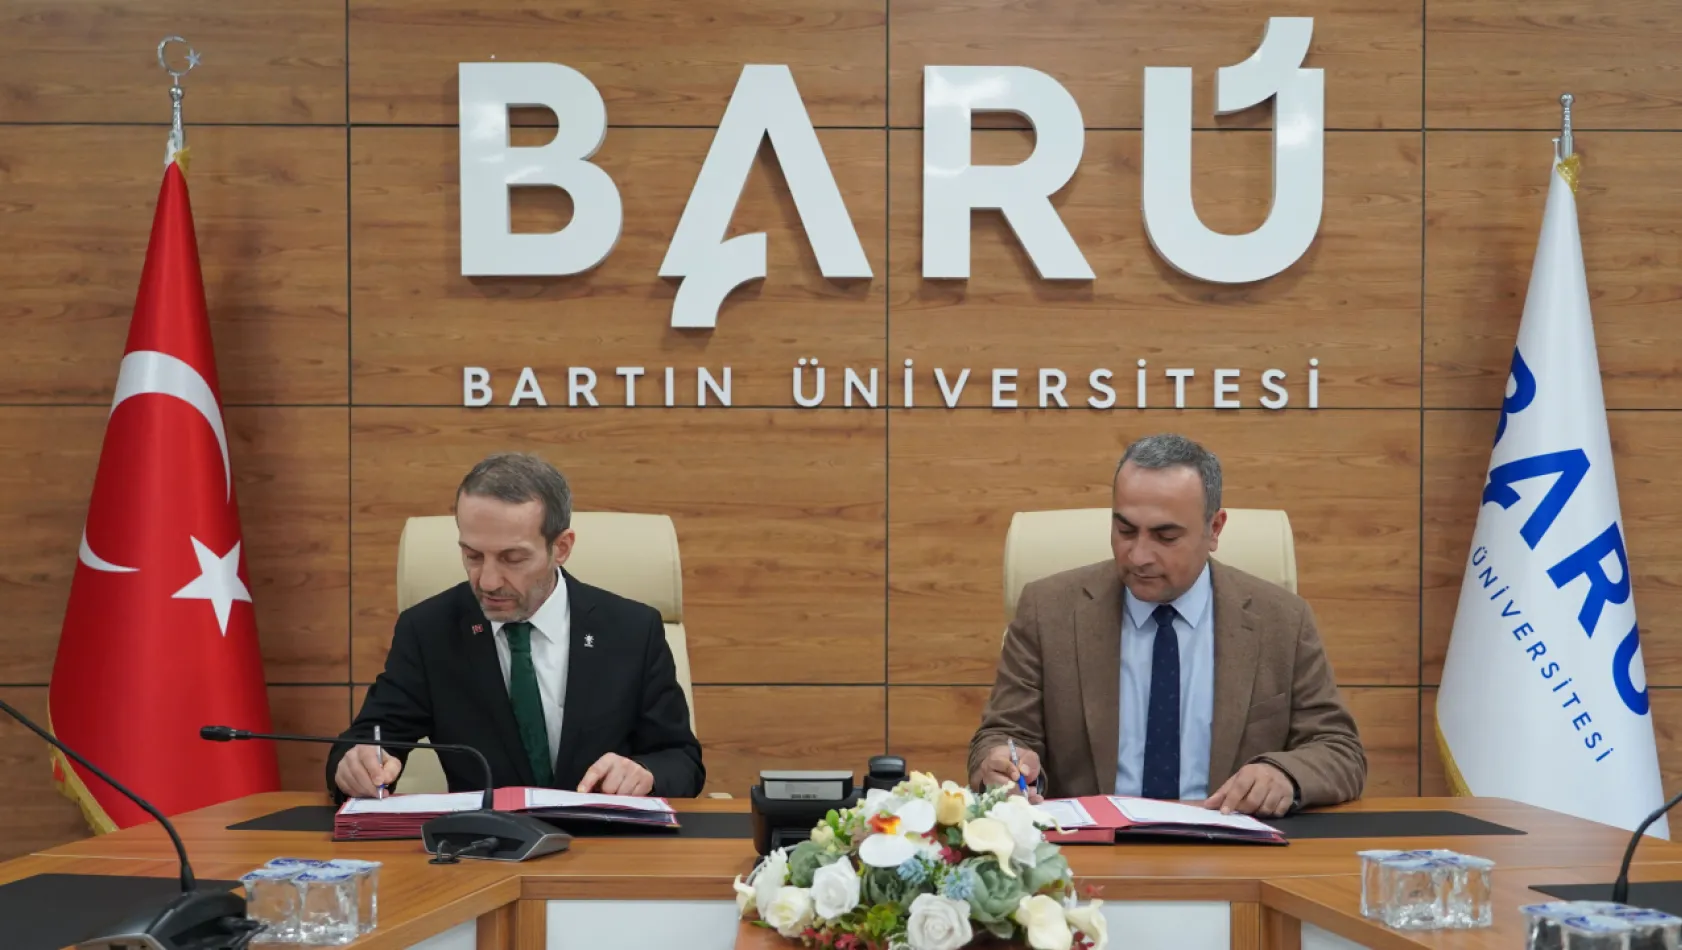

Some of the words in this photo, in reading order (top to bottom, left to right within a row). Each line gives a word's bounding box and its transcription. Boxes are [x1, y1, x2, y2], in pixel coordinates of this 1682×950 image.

[463, 366, 732, 407] BARTIN
[792, 358, 1320, 410] ÜNİVERSİTESİ
[1471, 545, 1615, 763] ÜNİVERSİTESİ
